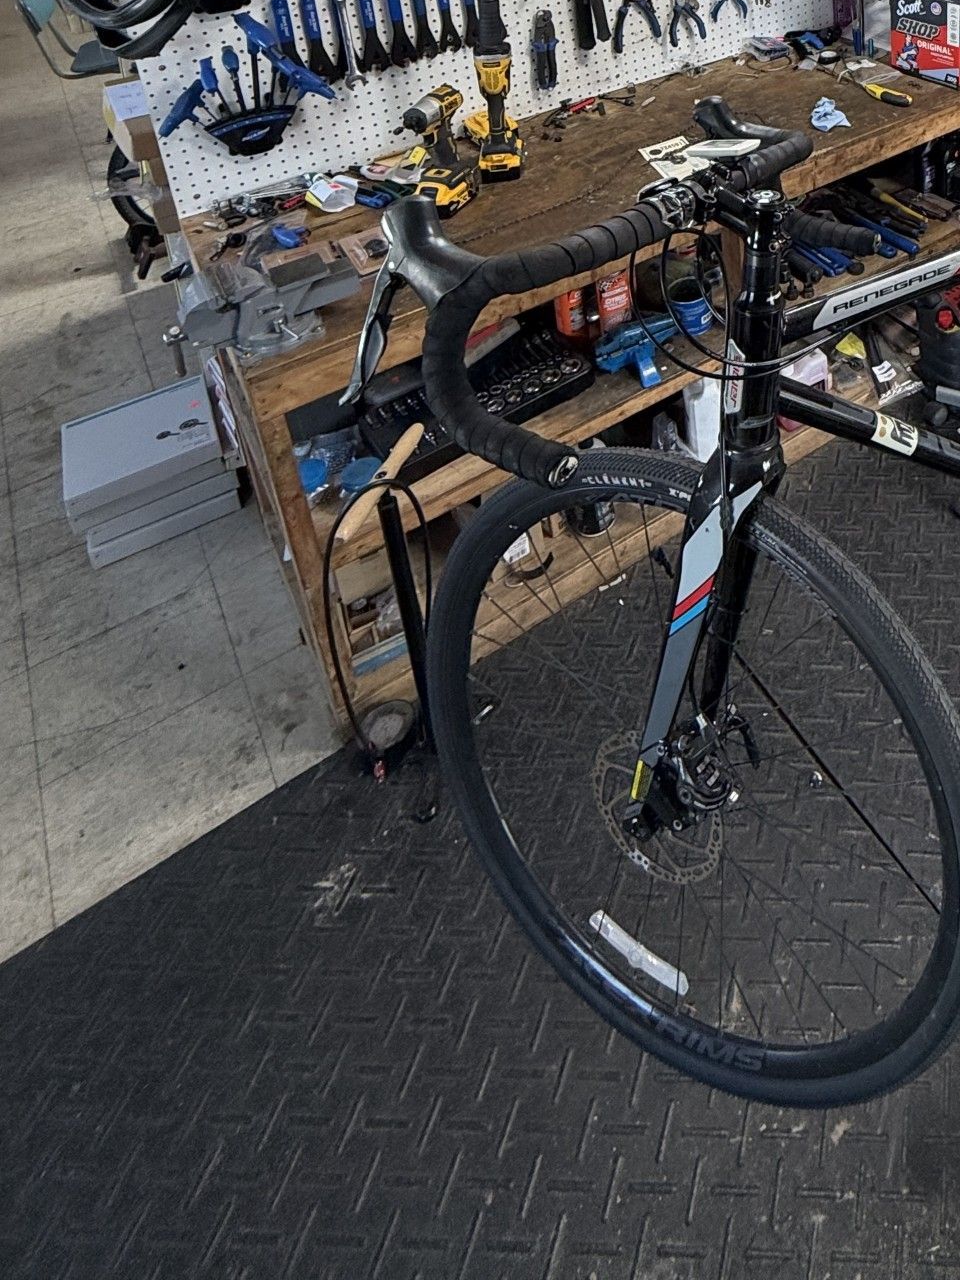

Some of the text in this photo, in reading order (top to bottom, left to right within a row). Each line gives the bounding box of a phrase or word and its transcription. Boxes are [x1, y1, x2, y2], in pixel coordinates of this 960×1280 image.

[897, 0, 923, 16] Scott
[896, 17, 940, 41] SHOP
[917, 40, 952, 56] ORIGINAL
[833, 264, 951, 314] RENEGADE
[655, 1016, 767, 1071] RIMS
